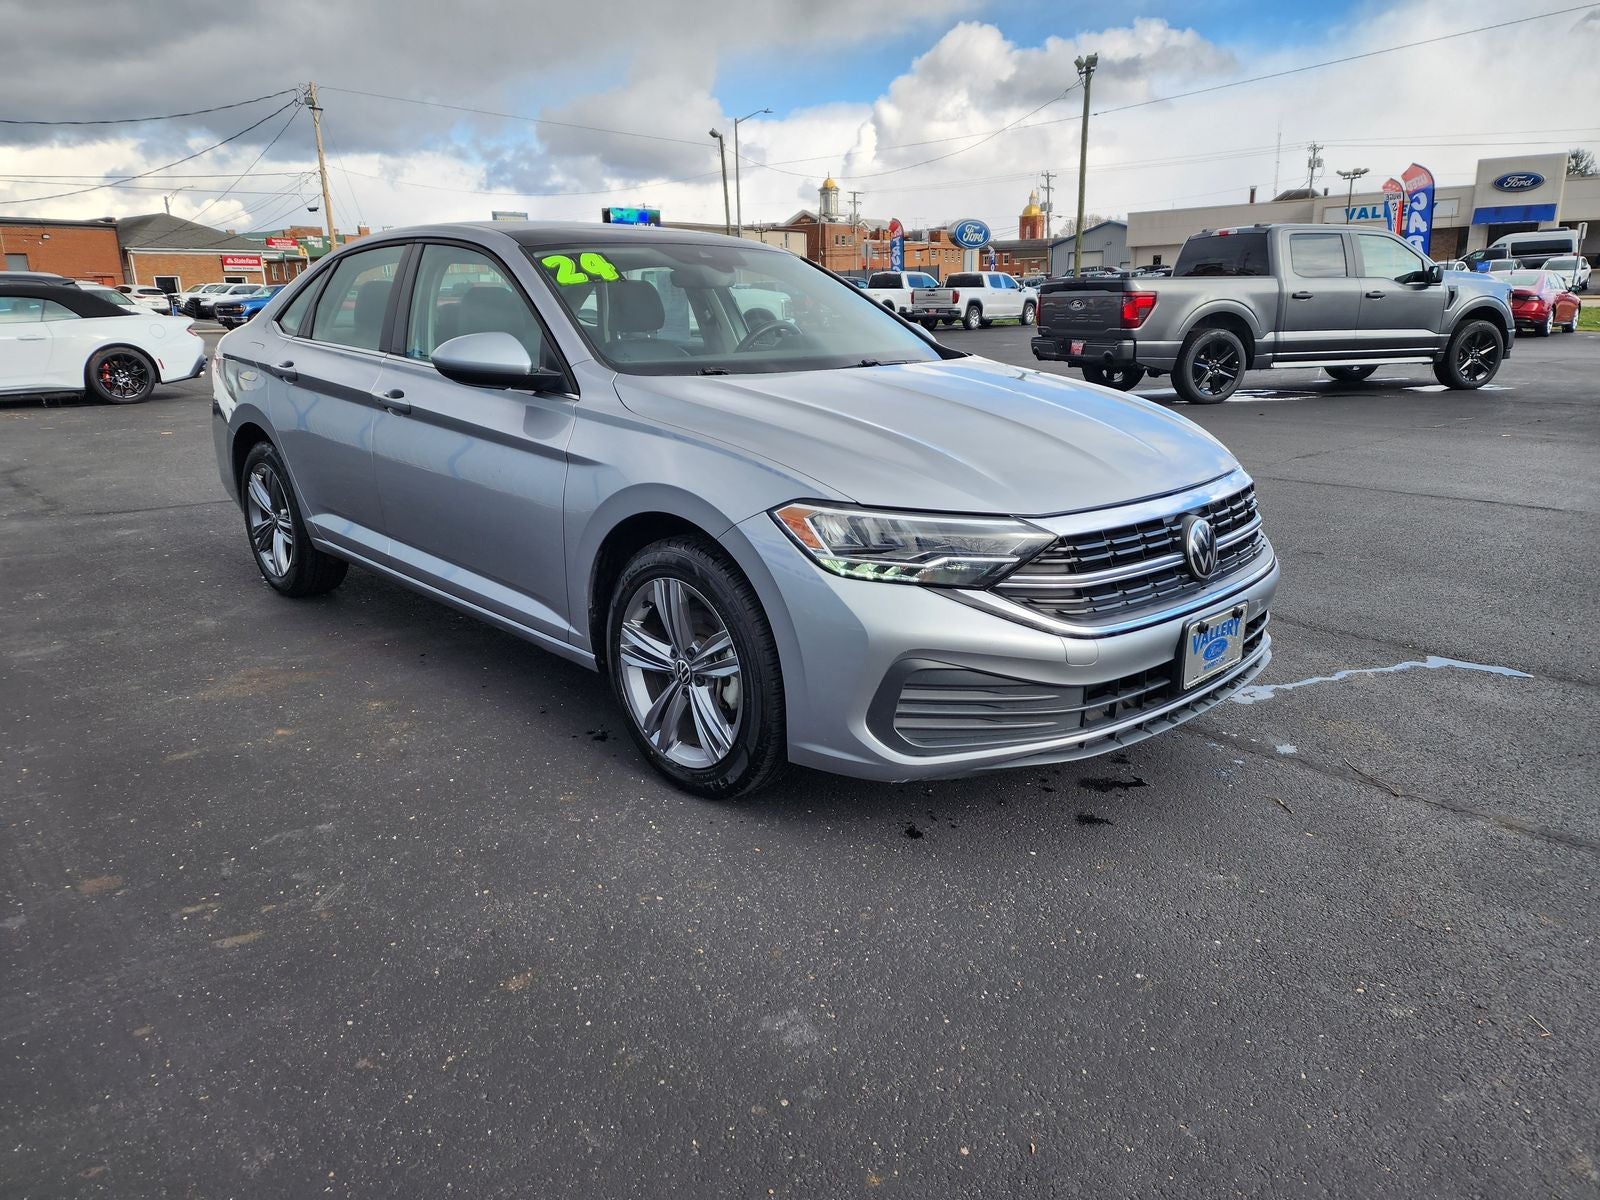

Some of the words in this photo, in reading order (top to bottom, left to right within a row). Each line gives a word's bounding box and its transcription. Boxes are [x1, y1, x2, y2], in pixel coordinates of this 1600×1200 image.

[1503, 175, 1535, 188] Ford
[962, 223, 985, 243] Ford
[541, 252, 620, 286] 24
[1192, 617, 1241, 656] VALLERY
